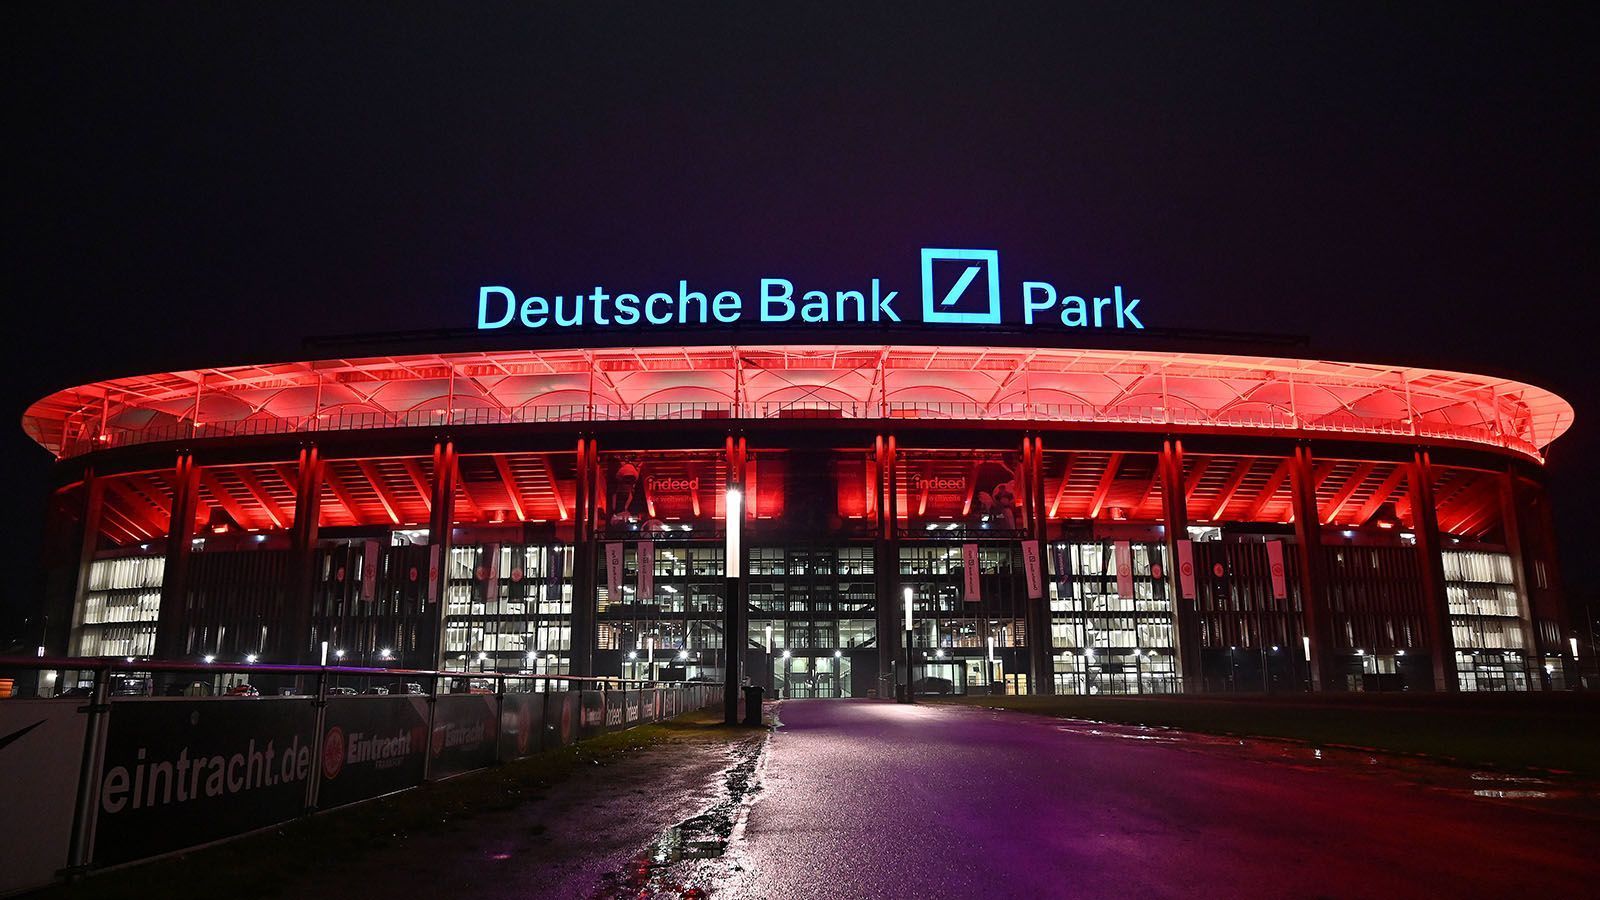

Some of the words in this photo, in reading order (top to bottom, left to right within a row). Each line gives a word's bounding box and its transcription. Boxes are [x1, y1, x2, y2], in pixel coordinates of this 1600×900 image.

[477, 280, 742, 329] Deutsche
[760, 278, 901, 322] Bank
[1022, 281, 1144, 329] Park
[646, 475, 699, 490] indeed
[911, 474, 966, 489] indeed
[347, 727, 411, 764] Eintracht
[102, 735, 310, 813] eintracht.de
